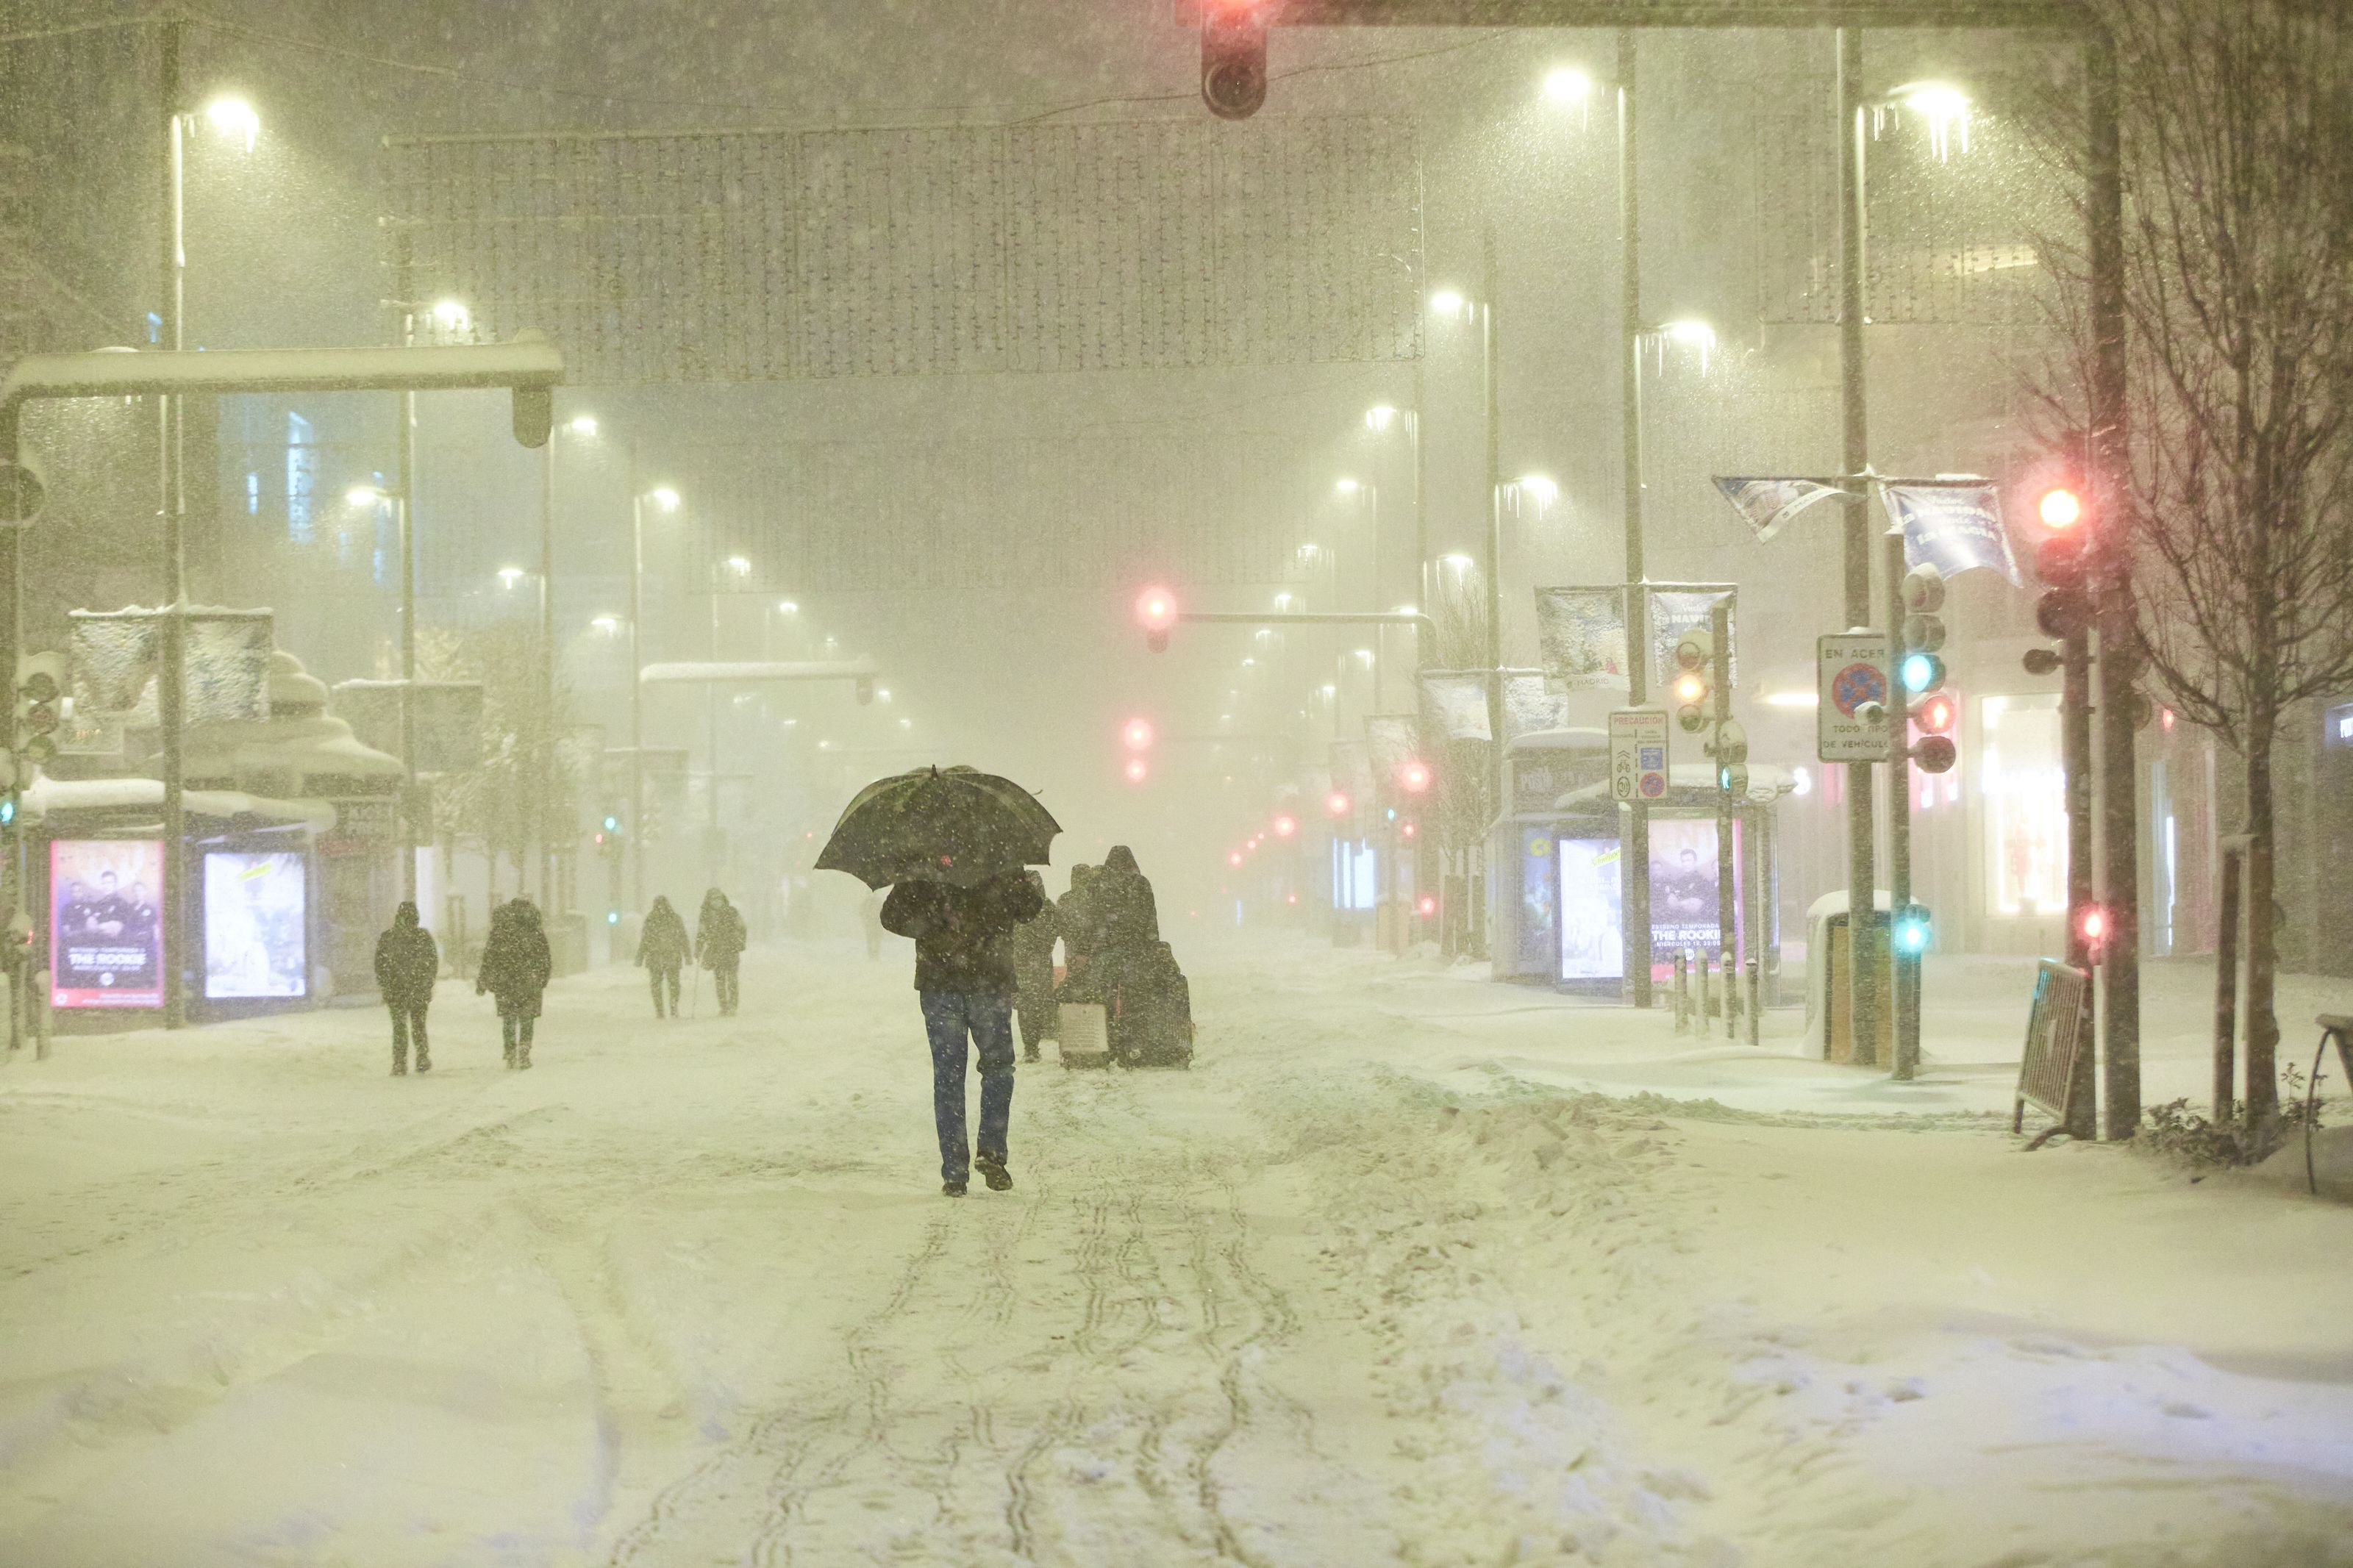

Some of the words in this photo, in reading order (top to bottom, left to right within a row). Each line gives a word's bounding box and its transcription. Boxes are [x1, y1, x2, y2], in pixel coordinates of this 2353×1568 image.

[1826, 649, 1843, 659] EN
[1851, 649, 1885, 659] ACER
[1824, 740, 1836, 748] DE
[1651, 930, 1676, 941] THE
[68, 953, 95, 965] THE
[96, 953, 147, 965] ROOKIE
